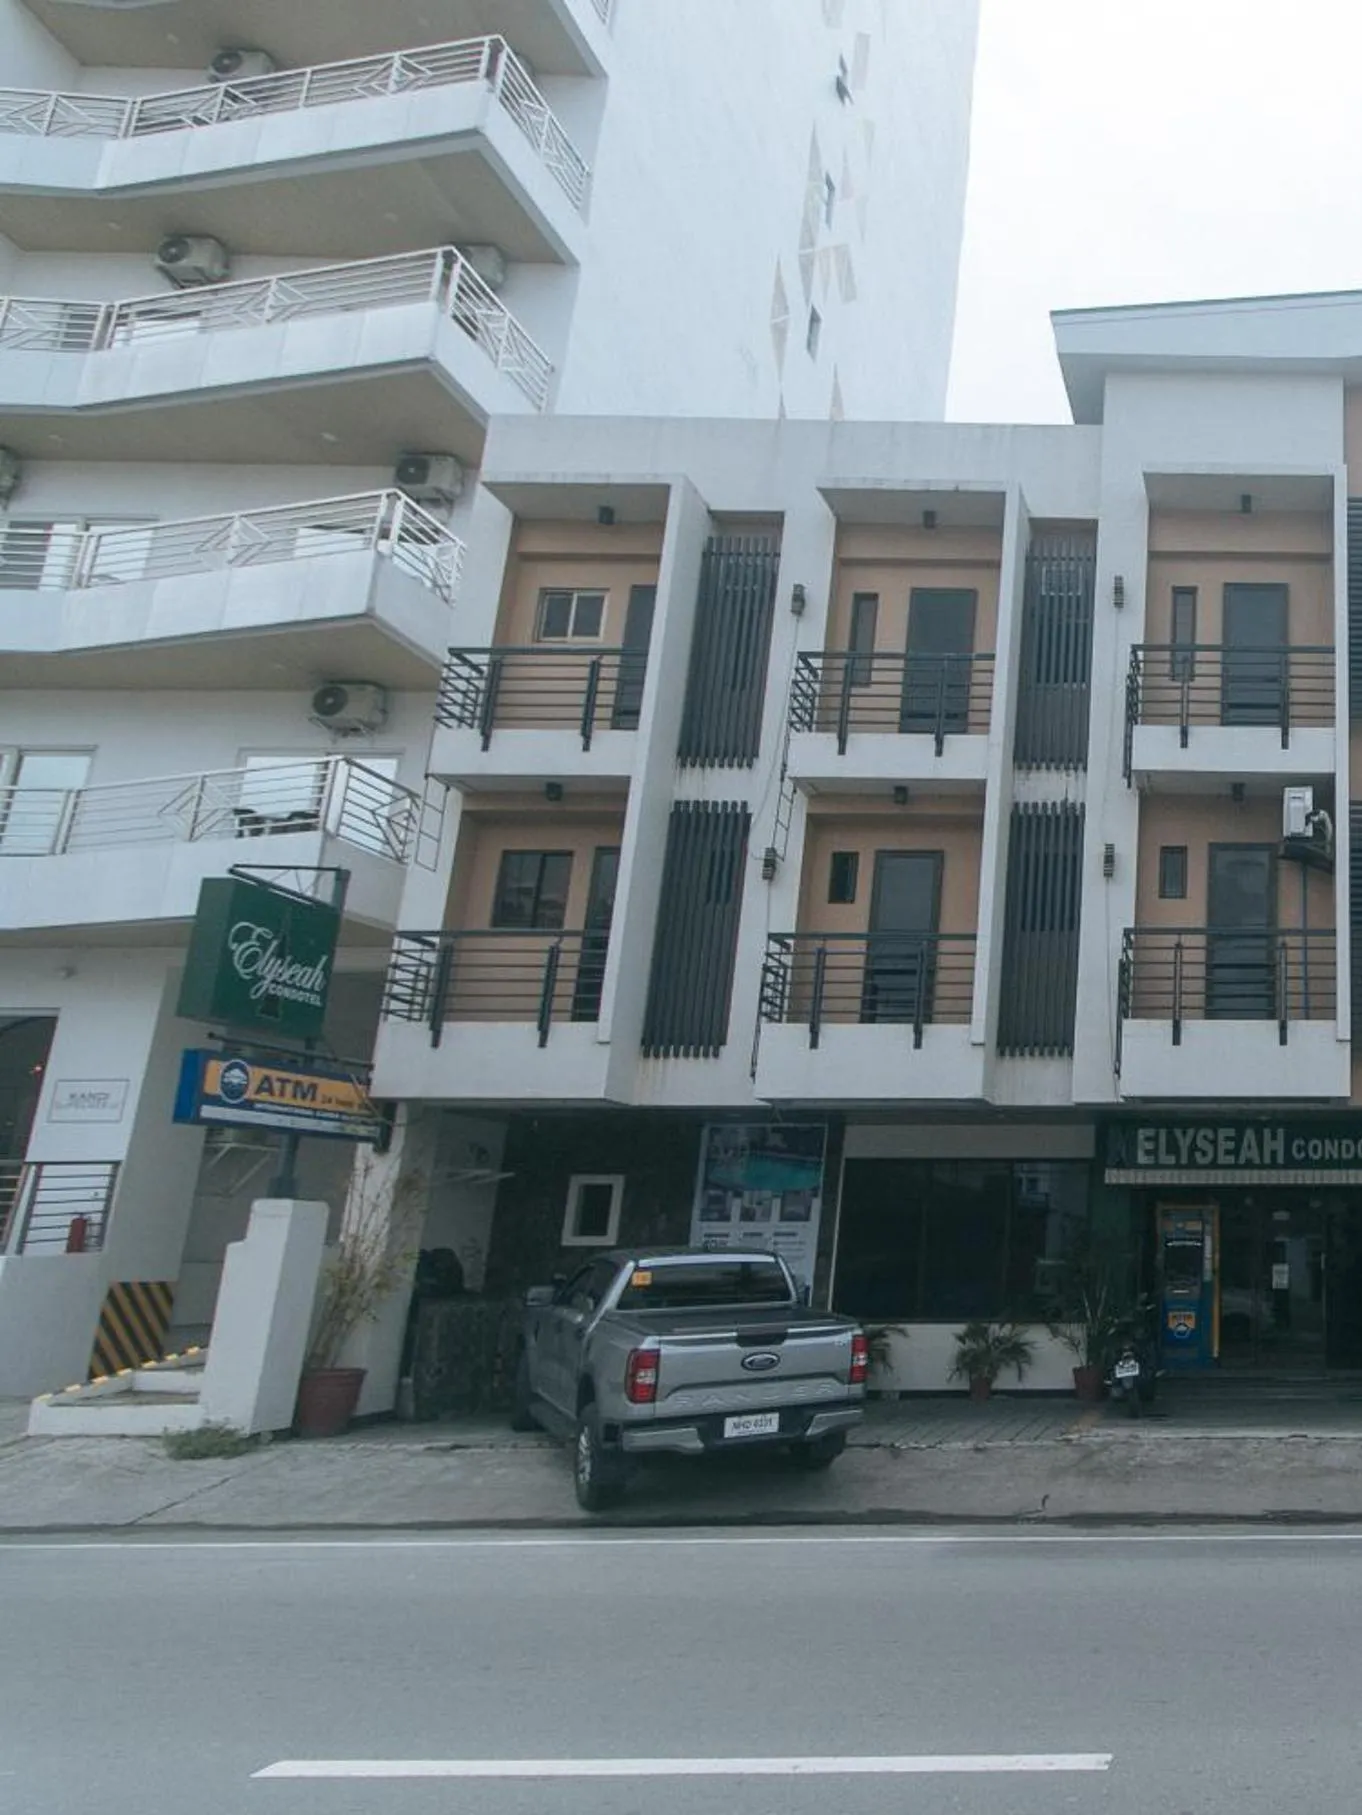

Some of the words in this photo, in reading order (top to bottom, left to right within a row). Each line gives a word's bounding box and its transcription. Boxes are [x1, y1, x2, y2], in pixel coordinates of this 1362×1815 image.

[228, 921, 328, 999] Elyseah
[255, 1075, 318, 1102] ATM
[1136, 1127, 1285, 1165] ELYSEAH
